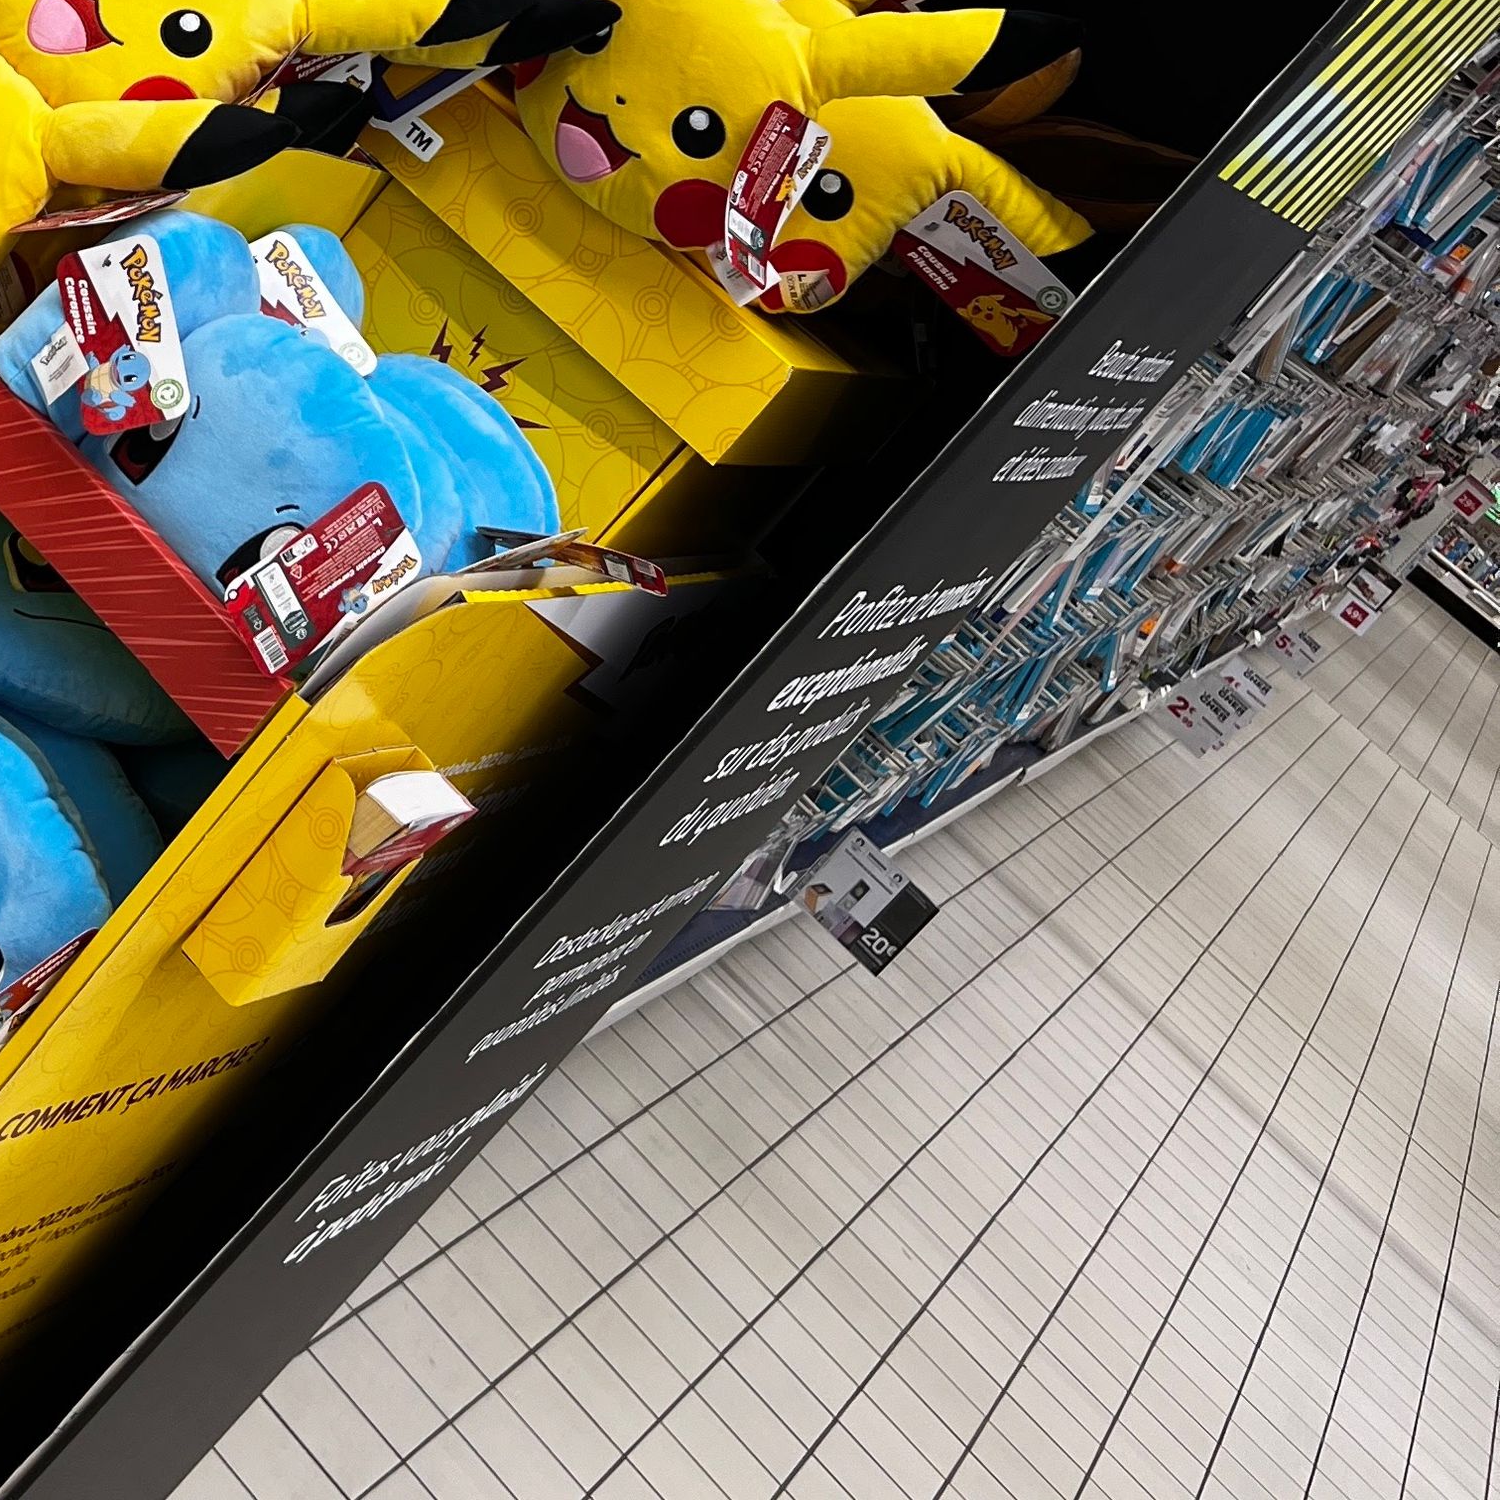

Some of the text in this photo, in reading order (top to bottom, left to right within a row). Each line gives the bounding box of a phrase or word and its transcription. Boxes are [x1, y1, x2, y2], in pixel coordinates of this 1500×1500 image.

[404, 120, 437, 153] TM
[992, 450, 1027, 482] et
[817, 583, 916, 640] Profitez
[898, 578, 945, 627] de
[766, 634, 928, 715] exceptionnelles
[703, 742, 764, 783] sur
[745, 723, 800, 771] des
[659, 797, 710, 847] du
[533, 910, 646, 969] Destockage
[120, 1076, 168, 1116] ÇA
[158, 1046, 253, 1098] MARCHE
[295, 1112, 469, 1222] Faites vous
[28, 1206, 74, 1234] 2023
[296, 1180, 402, 1263] petit
